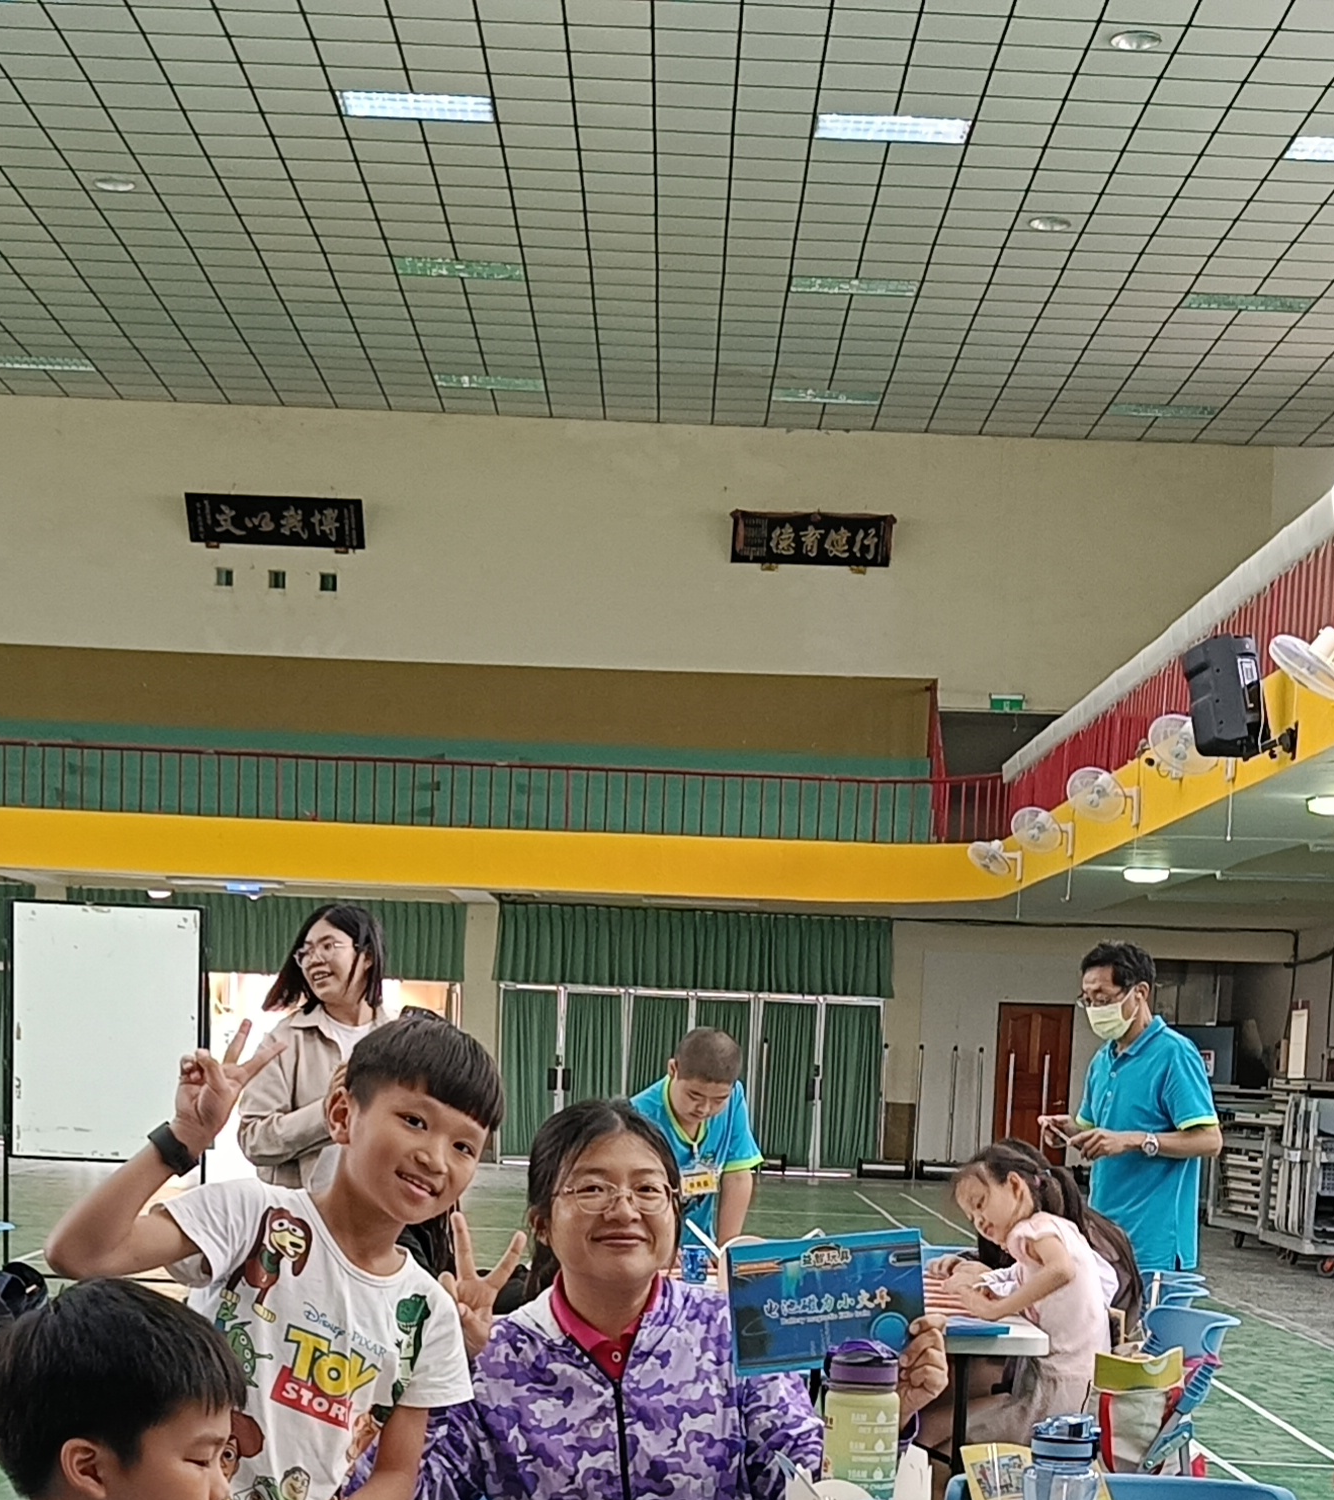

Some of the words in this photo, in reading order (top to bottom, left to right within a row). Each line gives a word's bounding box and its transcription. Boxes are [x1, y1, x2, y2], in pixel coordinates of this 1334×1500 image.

[284, 1323, 382, 1400] TOY
[351, 1331, 388, 1358] PIXAR
[281, 1381, 351, 1423] STOR
